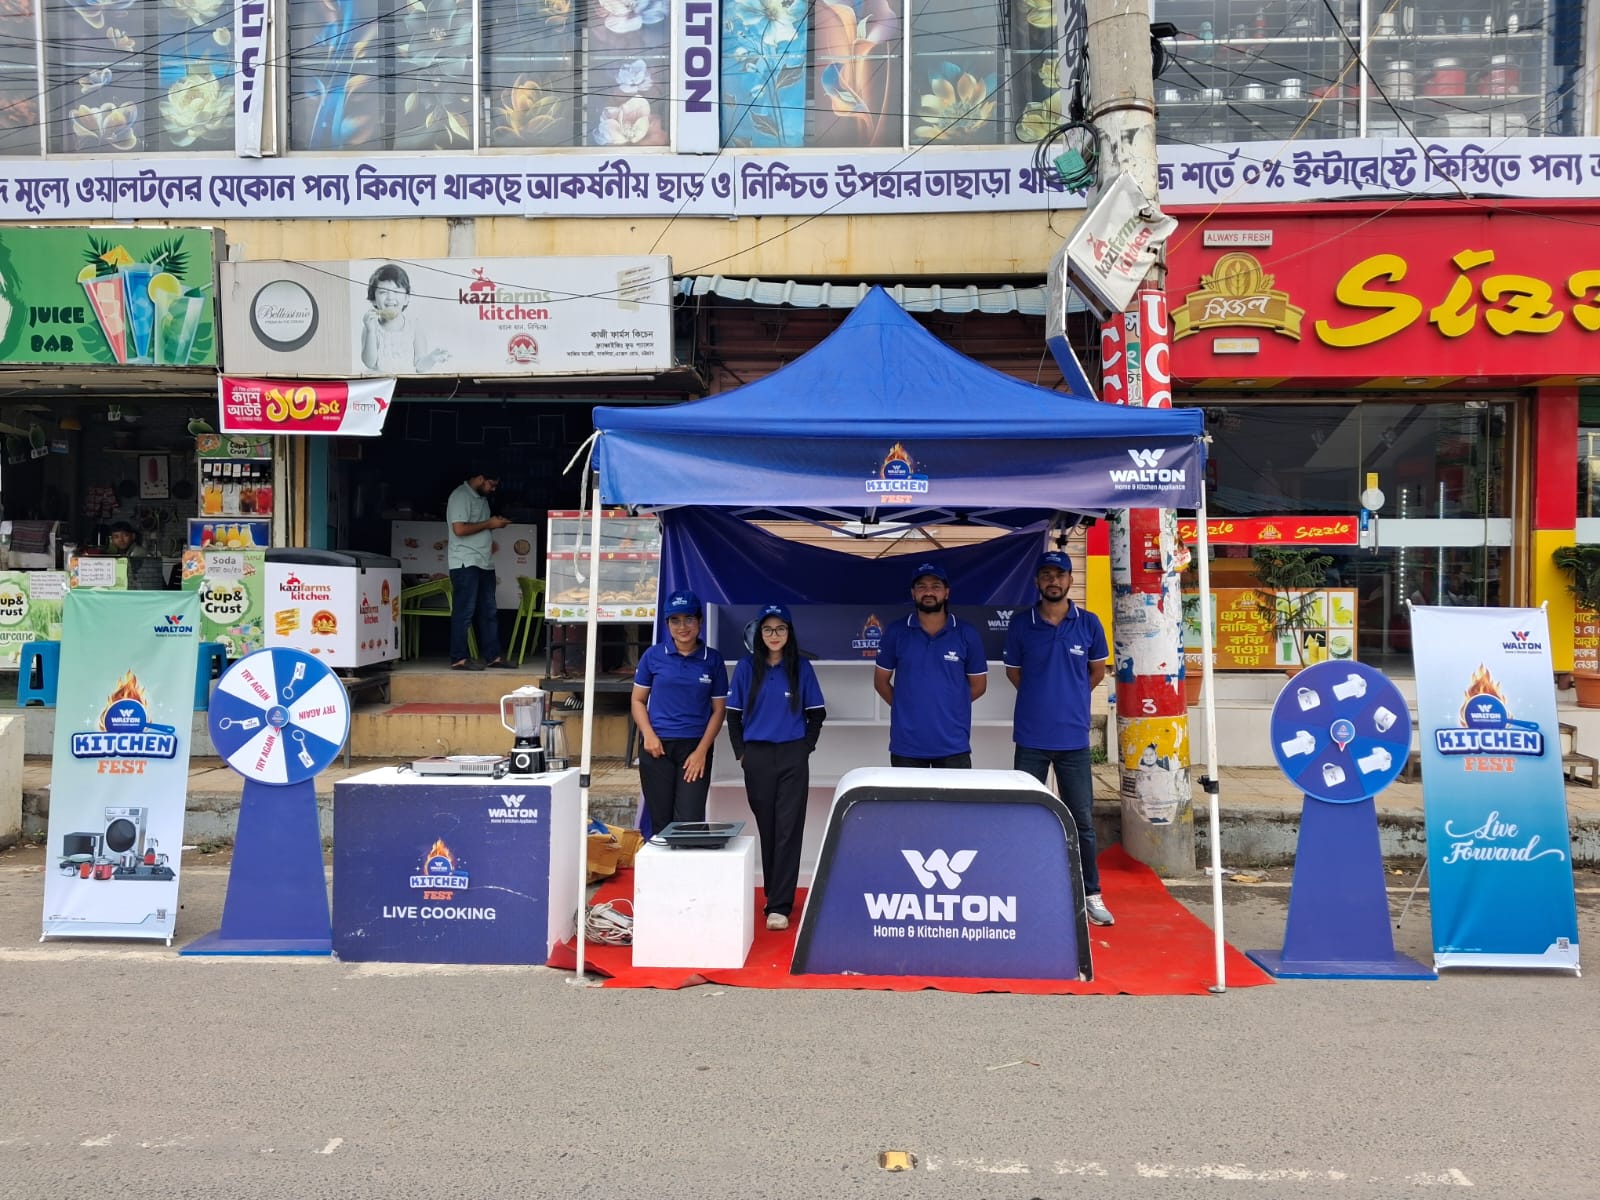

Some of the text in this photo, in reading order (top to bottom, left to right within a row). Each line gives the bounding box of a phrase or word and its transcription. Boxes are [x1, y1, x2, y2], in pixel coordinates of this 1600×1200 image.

[1181, 147, 1241, 195] শর্তে
[1243, 157, 1286, 189] ০%
[1424, 144, 1522, 188] কিস্তিতে
[15, 177, 70, 215] মূল্যে
[76, 169, 202, 208] ওয়ালটনের
[209, 174, 295, 208] যেকোন
[355, 163, 436, 206] কিনলে
[443, 173, 523, 206] থাকছে
[656, 172, 706, 202] ছাড়
[711, 172, 731, 199] ও
[741, 162, 829, 200] নিশ্চিত
[835, 163, 921, 200] উপহার
[925, 167, 1011, 200] তাছাড়া
[1207, 233, 1270, 242] ALWAYS FRESH
[459, 288, 550, 305] kazifarms
[29, 306, 85, 328] JUICE
[479, 305, 549, 321] kitchen
[30, 334, 74, 352] BAR
[1109, 469, 1186, 482] WALTON
[866, 480, 928, 492] KITCHEN
[1180, 521, 1234, 539] Sizle
[1295, 522, 1349, 539] Sizzle
[213, 556, 236, 565] Soda
[280, 583, 331, 592] kazifarms
[205, 591, 243, 603] Cup&
[291, 592, 330, 601] kitchen
[205, 603, 242, 614] Crust
[988, 619, 1010, 627] WALT
[1503, 642, 1541, 650] WALTON
[240, 669, 271, 701] TRY AGAIN
[298, 708, 321, 720] AGAIN
[322, 705, 336, 715] TRY
[1142, 698, 1157, 714] 3
[74, 735, 173, 754] KITCHEN
[1438, 732, 1539, 751] KITCHEN
[255, 734, 276, 772] TRY AGAIN
[97, 760, 147, 774] FEST
[1464, 757, 1516, 773] FEST
[488, 808, 538, 818] WALTON
[1445, 810, 1519, 840] Live
[1443, 835, 1565, 864] Forward
[411, 876, 468, 888] KITCHEN
[423, 890, 454, 900] FEST
[383, 905, 496, 920] LIVE COOKING
[864, 893, 1017, 922] WALTON
[873, 925, 1016, 941] Home & Kitchen Appliance
